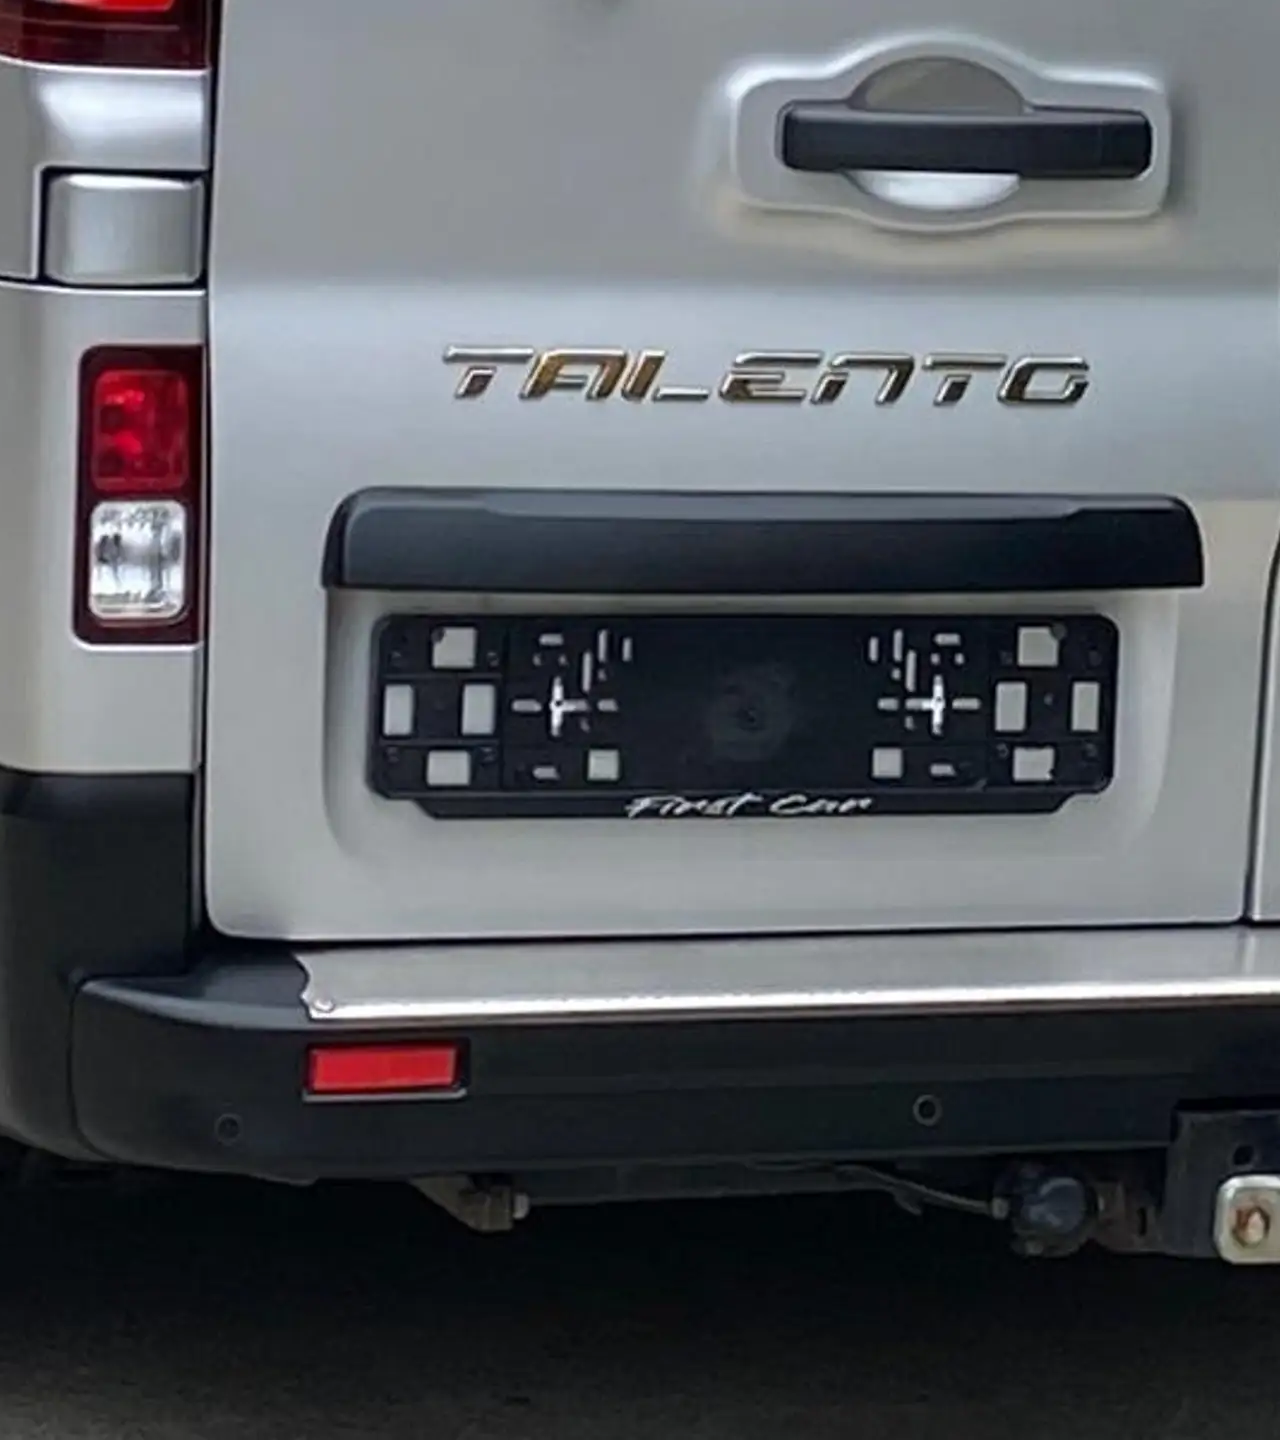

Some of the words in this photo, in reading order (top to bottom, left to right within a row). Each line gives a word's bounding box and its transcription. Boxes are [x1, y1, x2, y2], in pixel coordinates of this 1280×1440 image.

[442, 345, 1091, 406] TALENTO
[625, 792, 763, 819] First
[769, 794, 873, 816] Car
